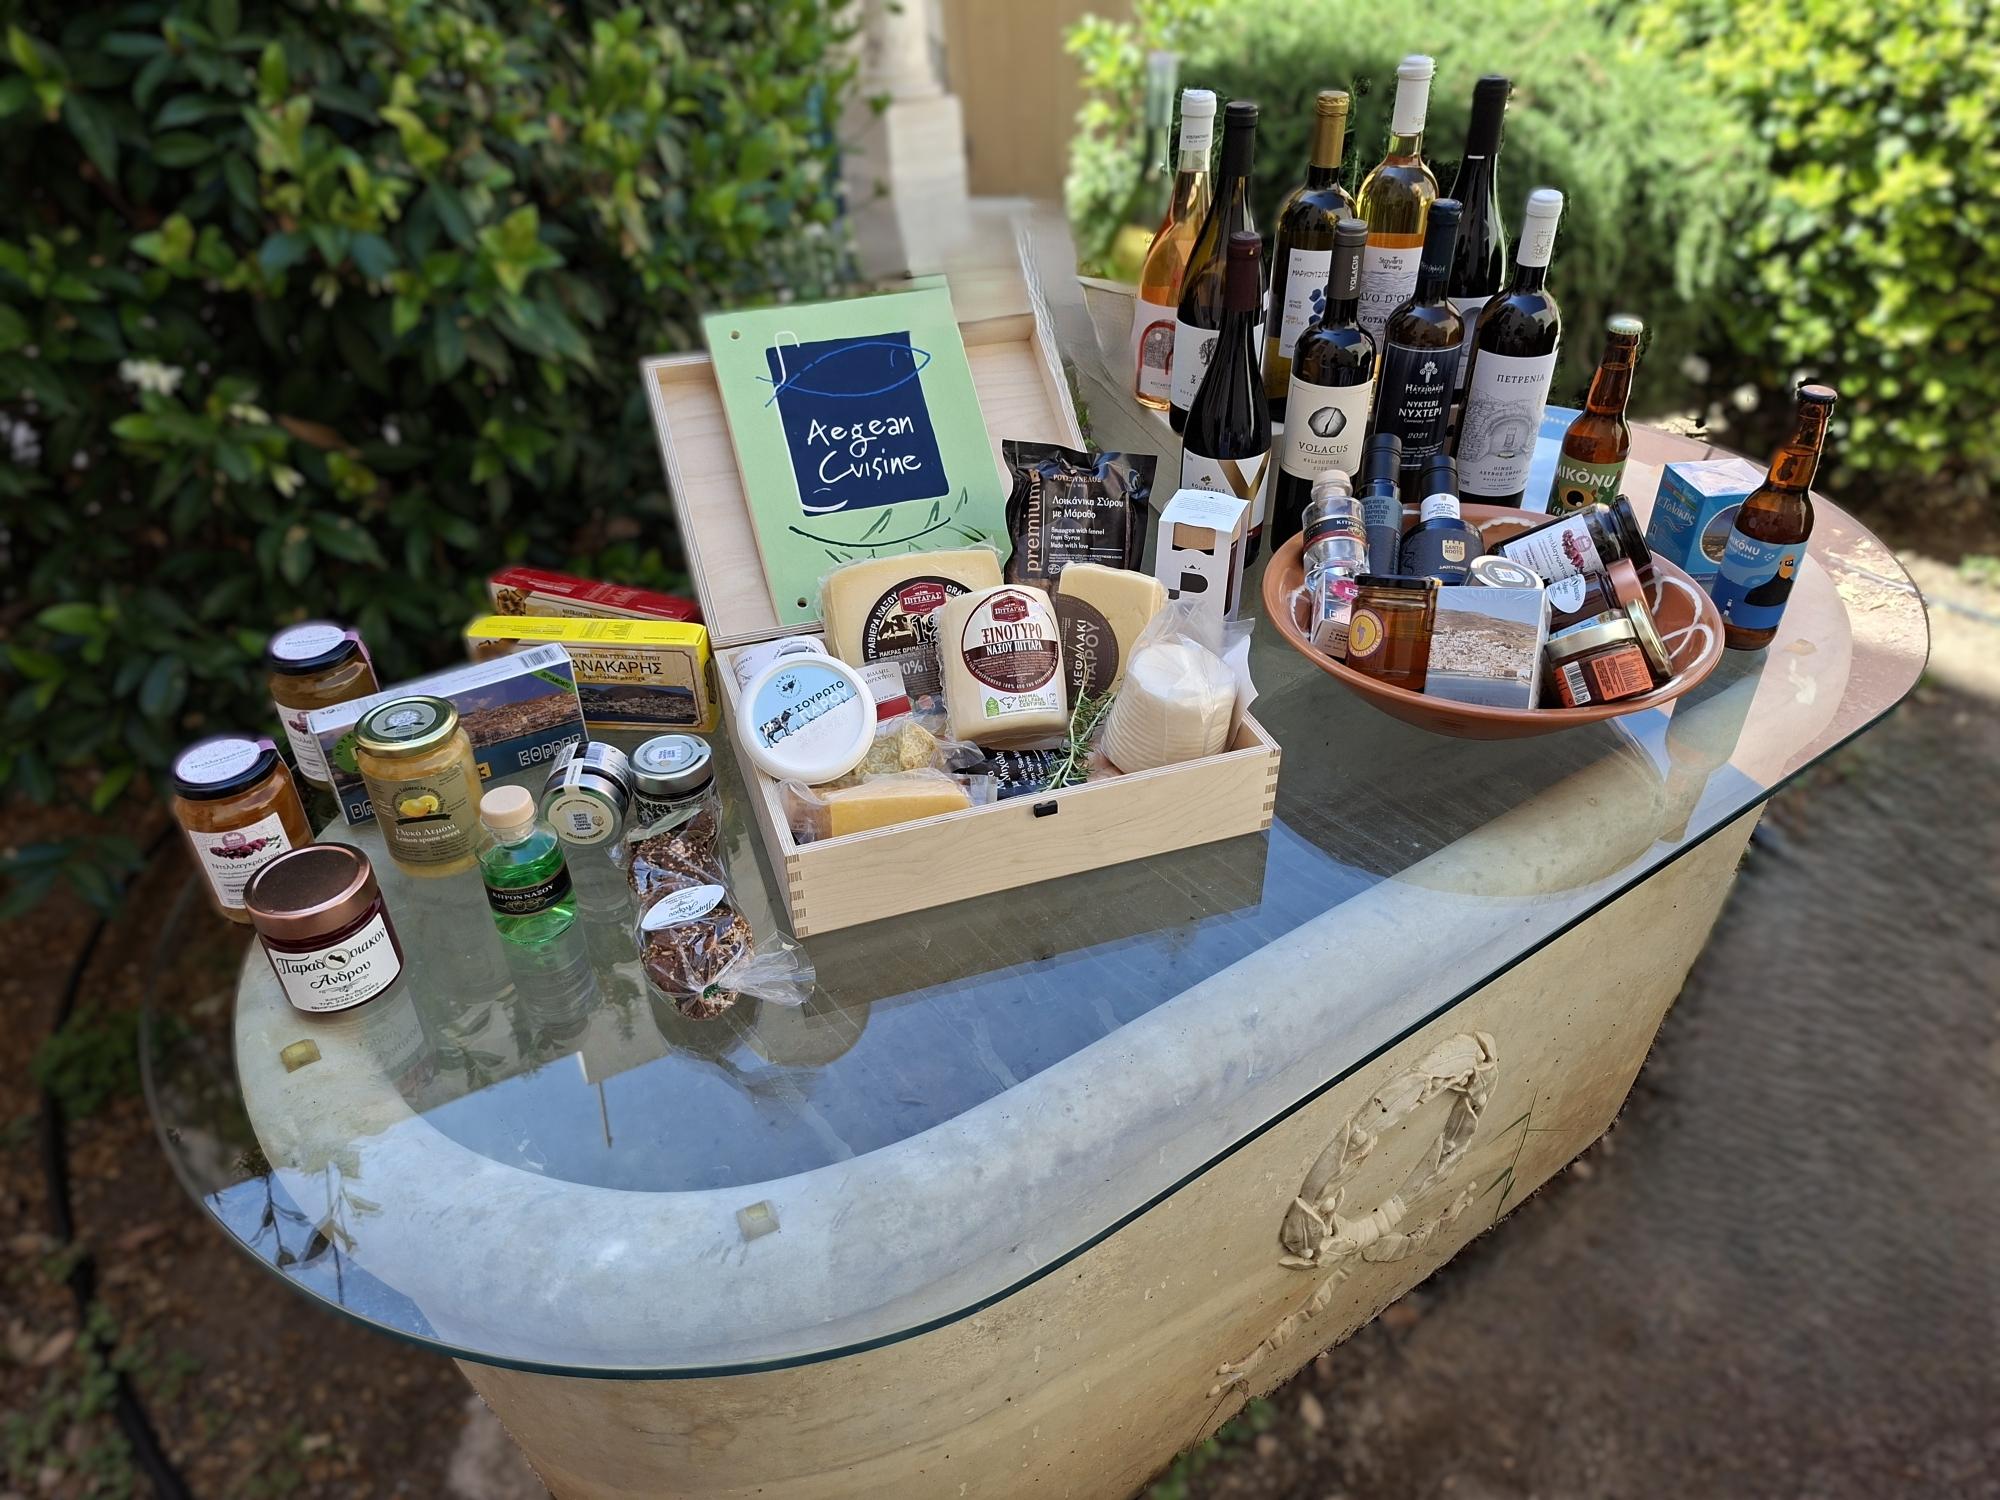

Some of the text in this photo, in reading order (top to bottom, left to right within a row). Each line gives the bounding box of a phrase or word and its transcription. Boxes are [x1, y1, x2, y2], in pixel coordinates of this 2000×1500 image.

[1349, 255, 1360, 291] VOLACUS
[807, 416, 914, 457] Aegean
[1298, 441, 1349, 453] VOLACUS
[819, 447, 922, 484] Cuisine
[1023, 479, 1042, 572] premium
[1063, 509, 1096, 519] Μάραθο
[868, 592, 899, 659] ΓΡΑΒΙΕΡΑ ΝΑΞΟΥ
[981, 623, 1042, 645] ΞΙΝΟΤΥΡΟ
[986, 640, 1043, 656] ΝΑΞΟΥ ΠΙΤΤΑΡΑ
[572, 660, 664, 675] ΑΝΑΚΑΡΗΣ
[795, 680, 845, 713] ΣΟΥΡΩΤΟ
[799, 686, 849, 721] ΠΑΡΟΥ
[420, 835, 441, 844] spoon
[424, 823, 456, 836] Λεμόνι
